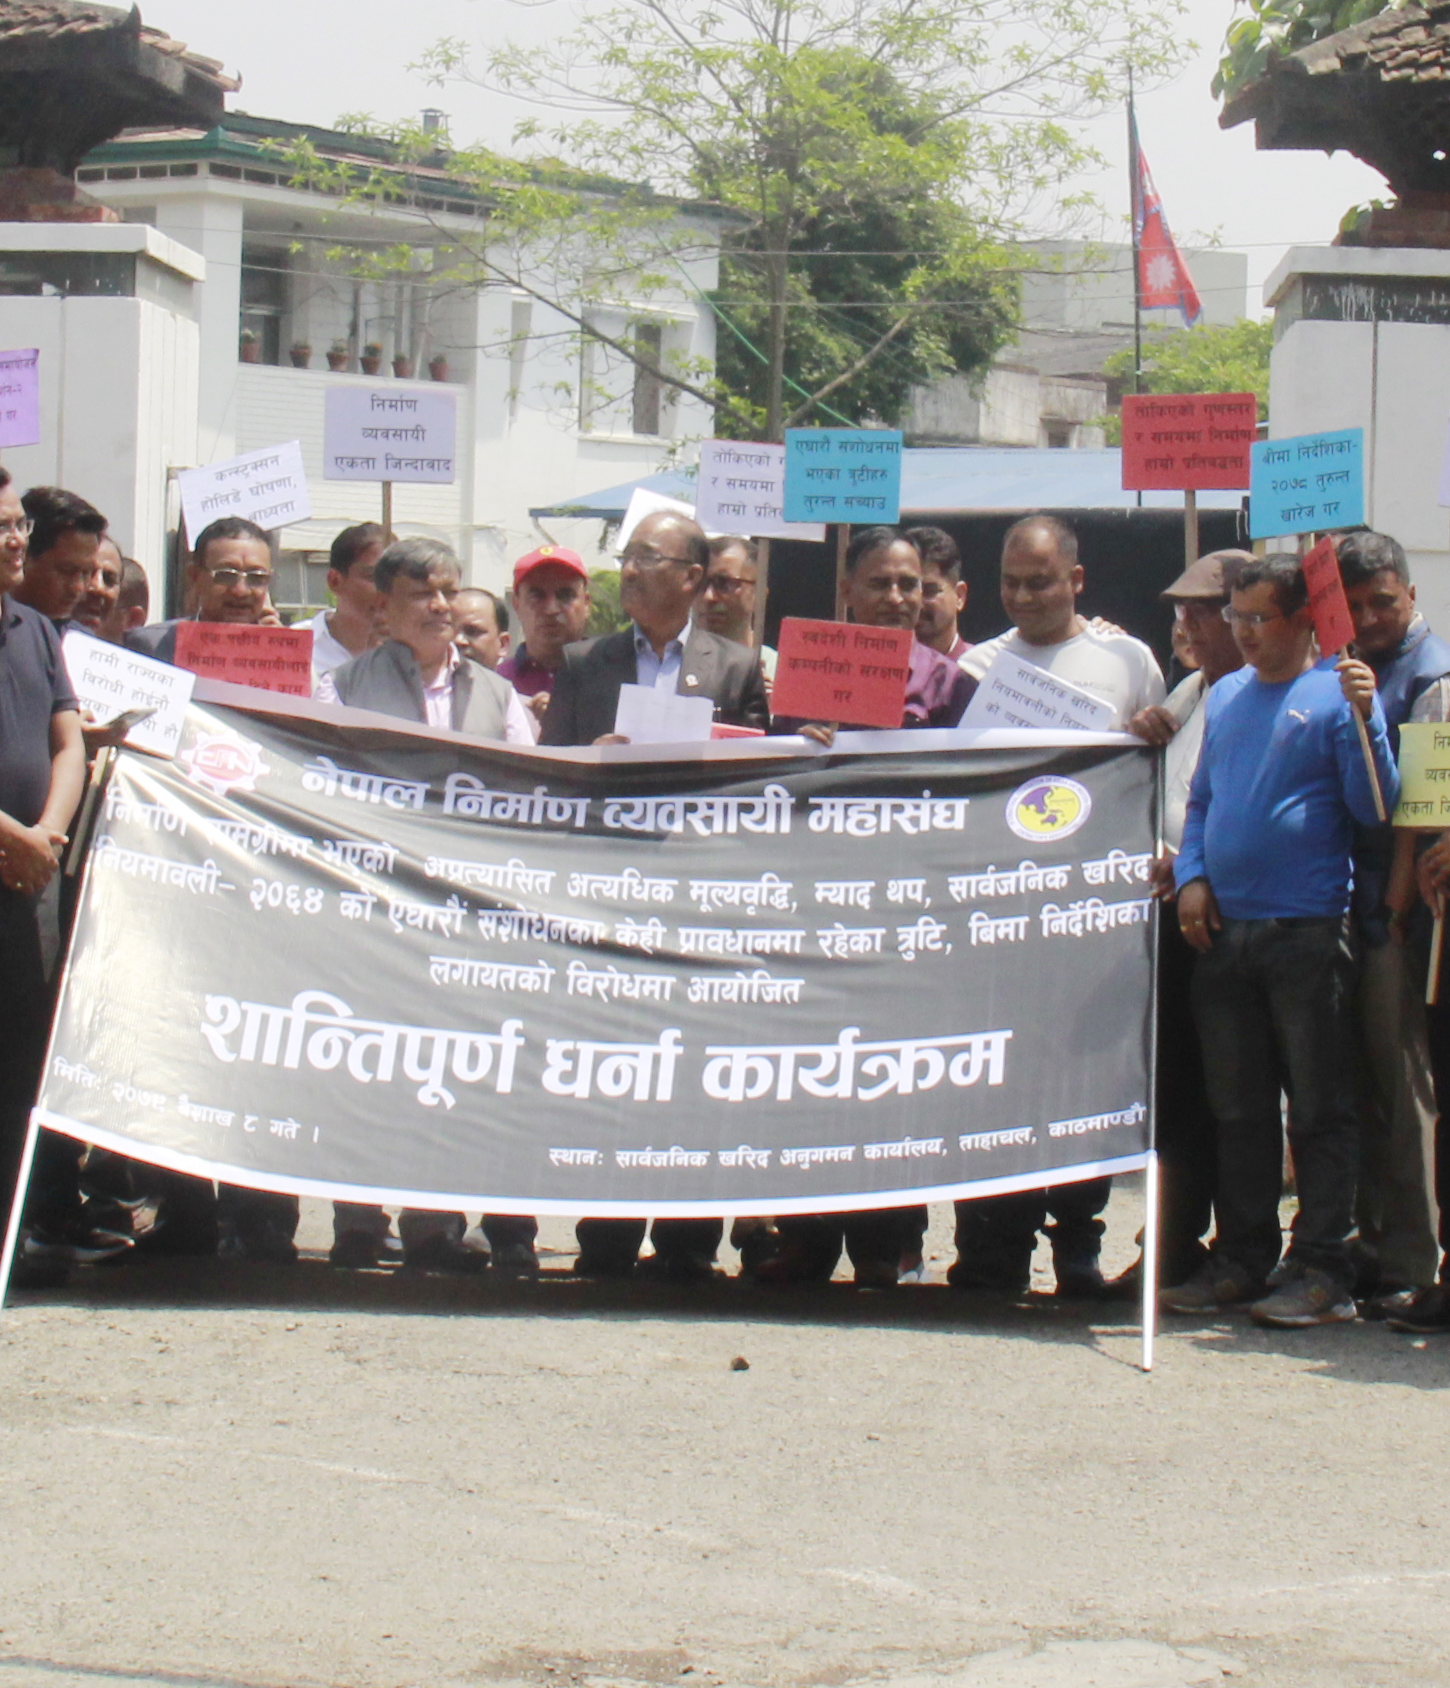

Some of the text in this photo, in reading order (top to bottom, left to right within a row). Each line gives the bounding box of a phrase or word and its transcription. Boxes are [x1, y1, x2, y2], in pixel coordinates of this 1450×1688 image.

[371, 394, 418, 412] निर्माण
[362, 425, 427, 442] व्यवसायी
[214, 454, 281, 481] कन्स्ट्रक्सन
[334, 456, 376, 473] एकता
[713, 448, 771, 468] तोकिएको
[711, 476, 775, 493] र समयमा
[805, 468, 841, 483] भएका
[201, 475, 297, 512] होलिडे घोषणा,
[1271, 478, 1307, 494] २०७८
[717, 502, 746, 517] हाम्रो
[1281, 501, 1340, 521] खारेज गर
[854, 632, 897, 652] निर्माण
[89, 649, 175, 688] हामी राज्यका
[833, 690, 852, 703] गर
[302, 755, 430, 811] नेपाल
[442, 773, 591, 828] निर्माण
[603, 783, 796, 836] व्यवसायी
[808, 789, 969, 837] महासंघ
[1402, 801, 1434, 818] एकता
[106, 784, 1153, 916] निर्माण भएको अप्रत्यासित अत्यधिक मूल्यवृद्धि, म्याद थप, सार्वजनिक खरिद
[249, 878, 324, 915] २०६४
[340, 885, 377, 922] को
[388, 893, 468, 939] एघारौं
[478, 901, 604, 945] संशोधनका
[615, 915, 667, 955] केही
[678, 925, 806, 955] प्रावधानमा
[815, 922, 887, 959] रहेका
[896, 914, 953, 962] त्रुटि,
[968, 911, 1030, 947] बिमा
[1040, 896, 1153, 938] निर्देशिका
[429, 955, 805, 1005] लगायतको विरोधमा आयोजित
[200, 989, 1013, 1110] शान्तिपूर्ण धर्ना कार्यक्रम
[269, 1117, 302, 1140] गते
[615, 1102, 1147, 1170] सार्वजनिक खरिद अनुगमन कार्यालय, ताहाचल, काठमाण्डौ
